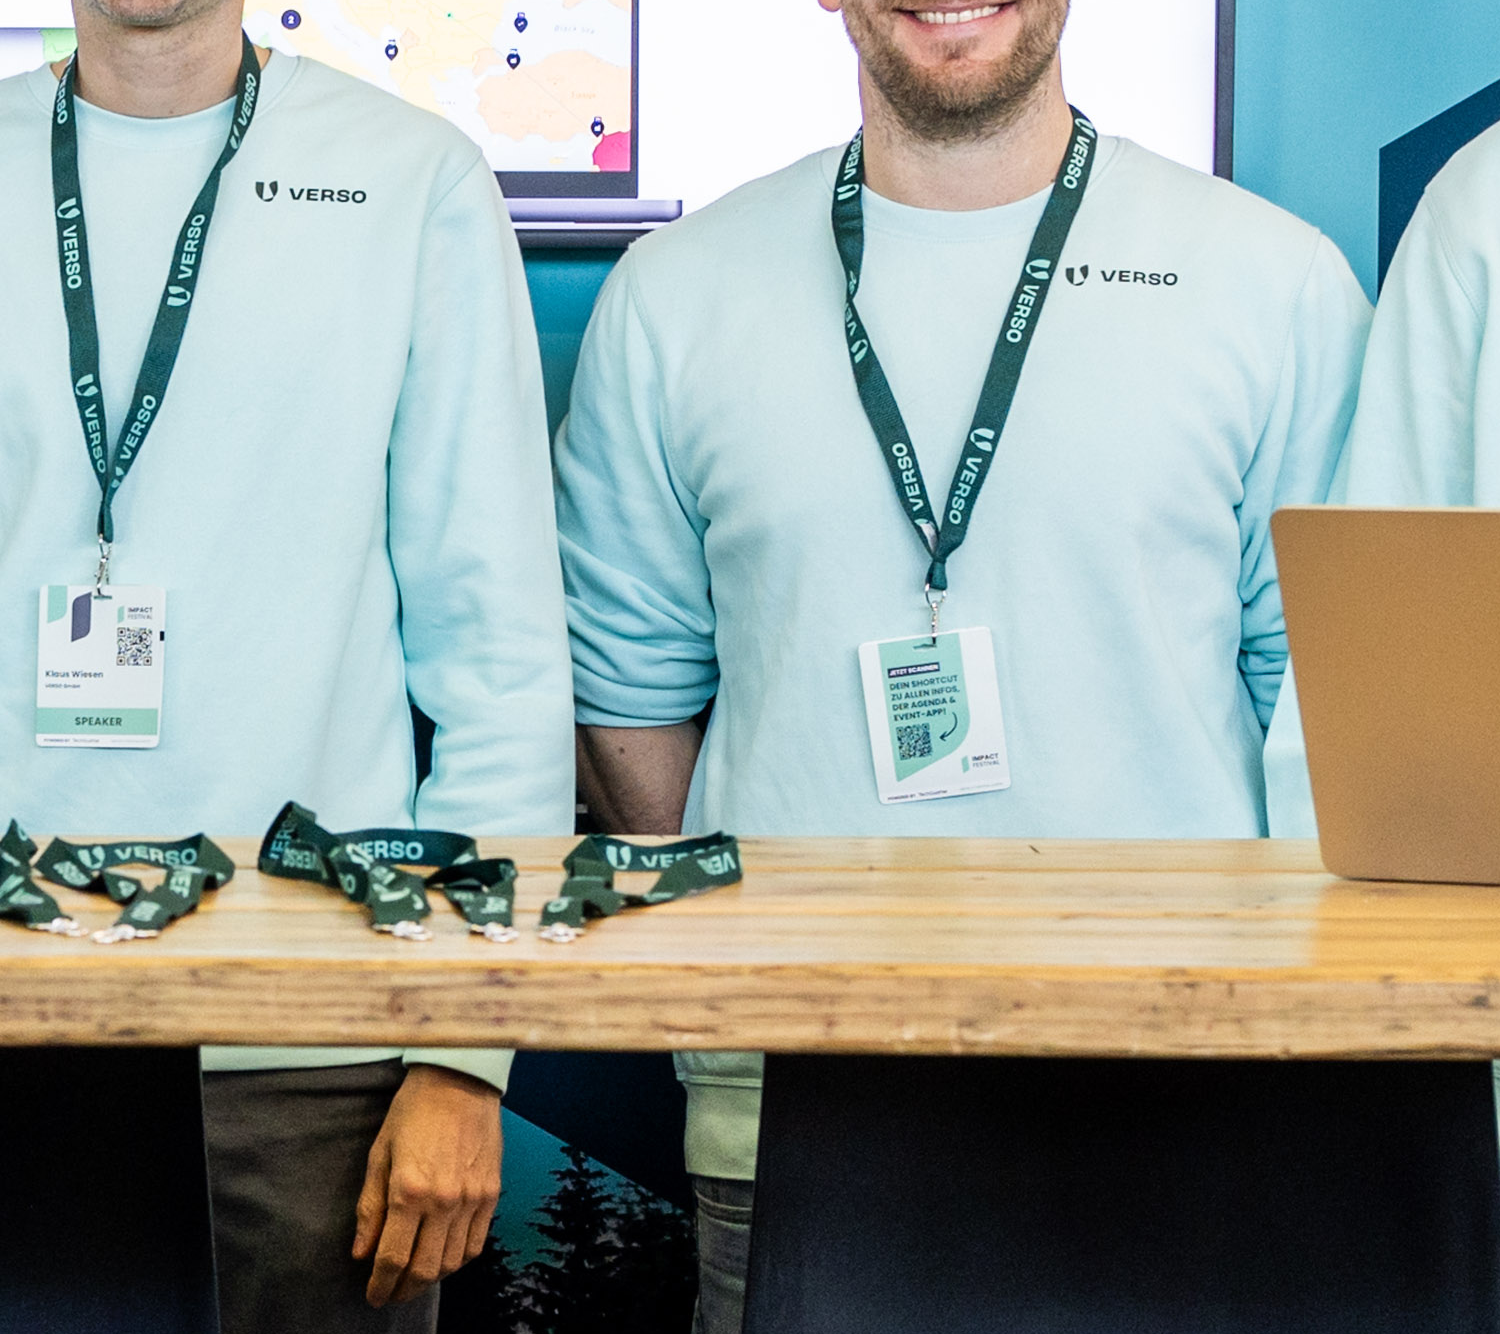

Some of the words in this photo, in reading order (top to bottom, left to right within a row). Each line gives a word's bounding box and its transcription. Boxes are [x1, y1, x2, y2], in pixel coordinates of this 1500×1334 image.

[237, 72, 257, 129] VERSO
[1062, 134, 1091, 190] VERSO
[290, 188, 366, 203] VERSO
[178, 213, 206, 280] VERSO
[63, 225, 82, 290] VERSO
[1101, 270, 1178, 286] VERSO
[1005, 283, 1039, 343] VERSO
[85, 404, 106, 474] VERSO
[119, 394, 157, 463] VERSO
[892, 442, 924, 512] VERSO
[948, 455, 982, 525] VERSO
[45, 670, 70, 678] Klaus
[890, 679, 910, 691] DEIN
[912, 675, 958, 688] SHORTCUT
[891, 692, 902, 701] ZU
[904, 691, 930, 700] ALLEN
[931, 687, 960, 695] INFOS,
[893, 703, 909, 711] DER
[911, 699, 947, 709] AGENDA
[894, 708, 946, 721] EVENT-APP!
[75, 717, 122, 726] SPEAKER
[972, 753, 998, 761] IMPACT
[114, 845, 197, 866] VERSO
